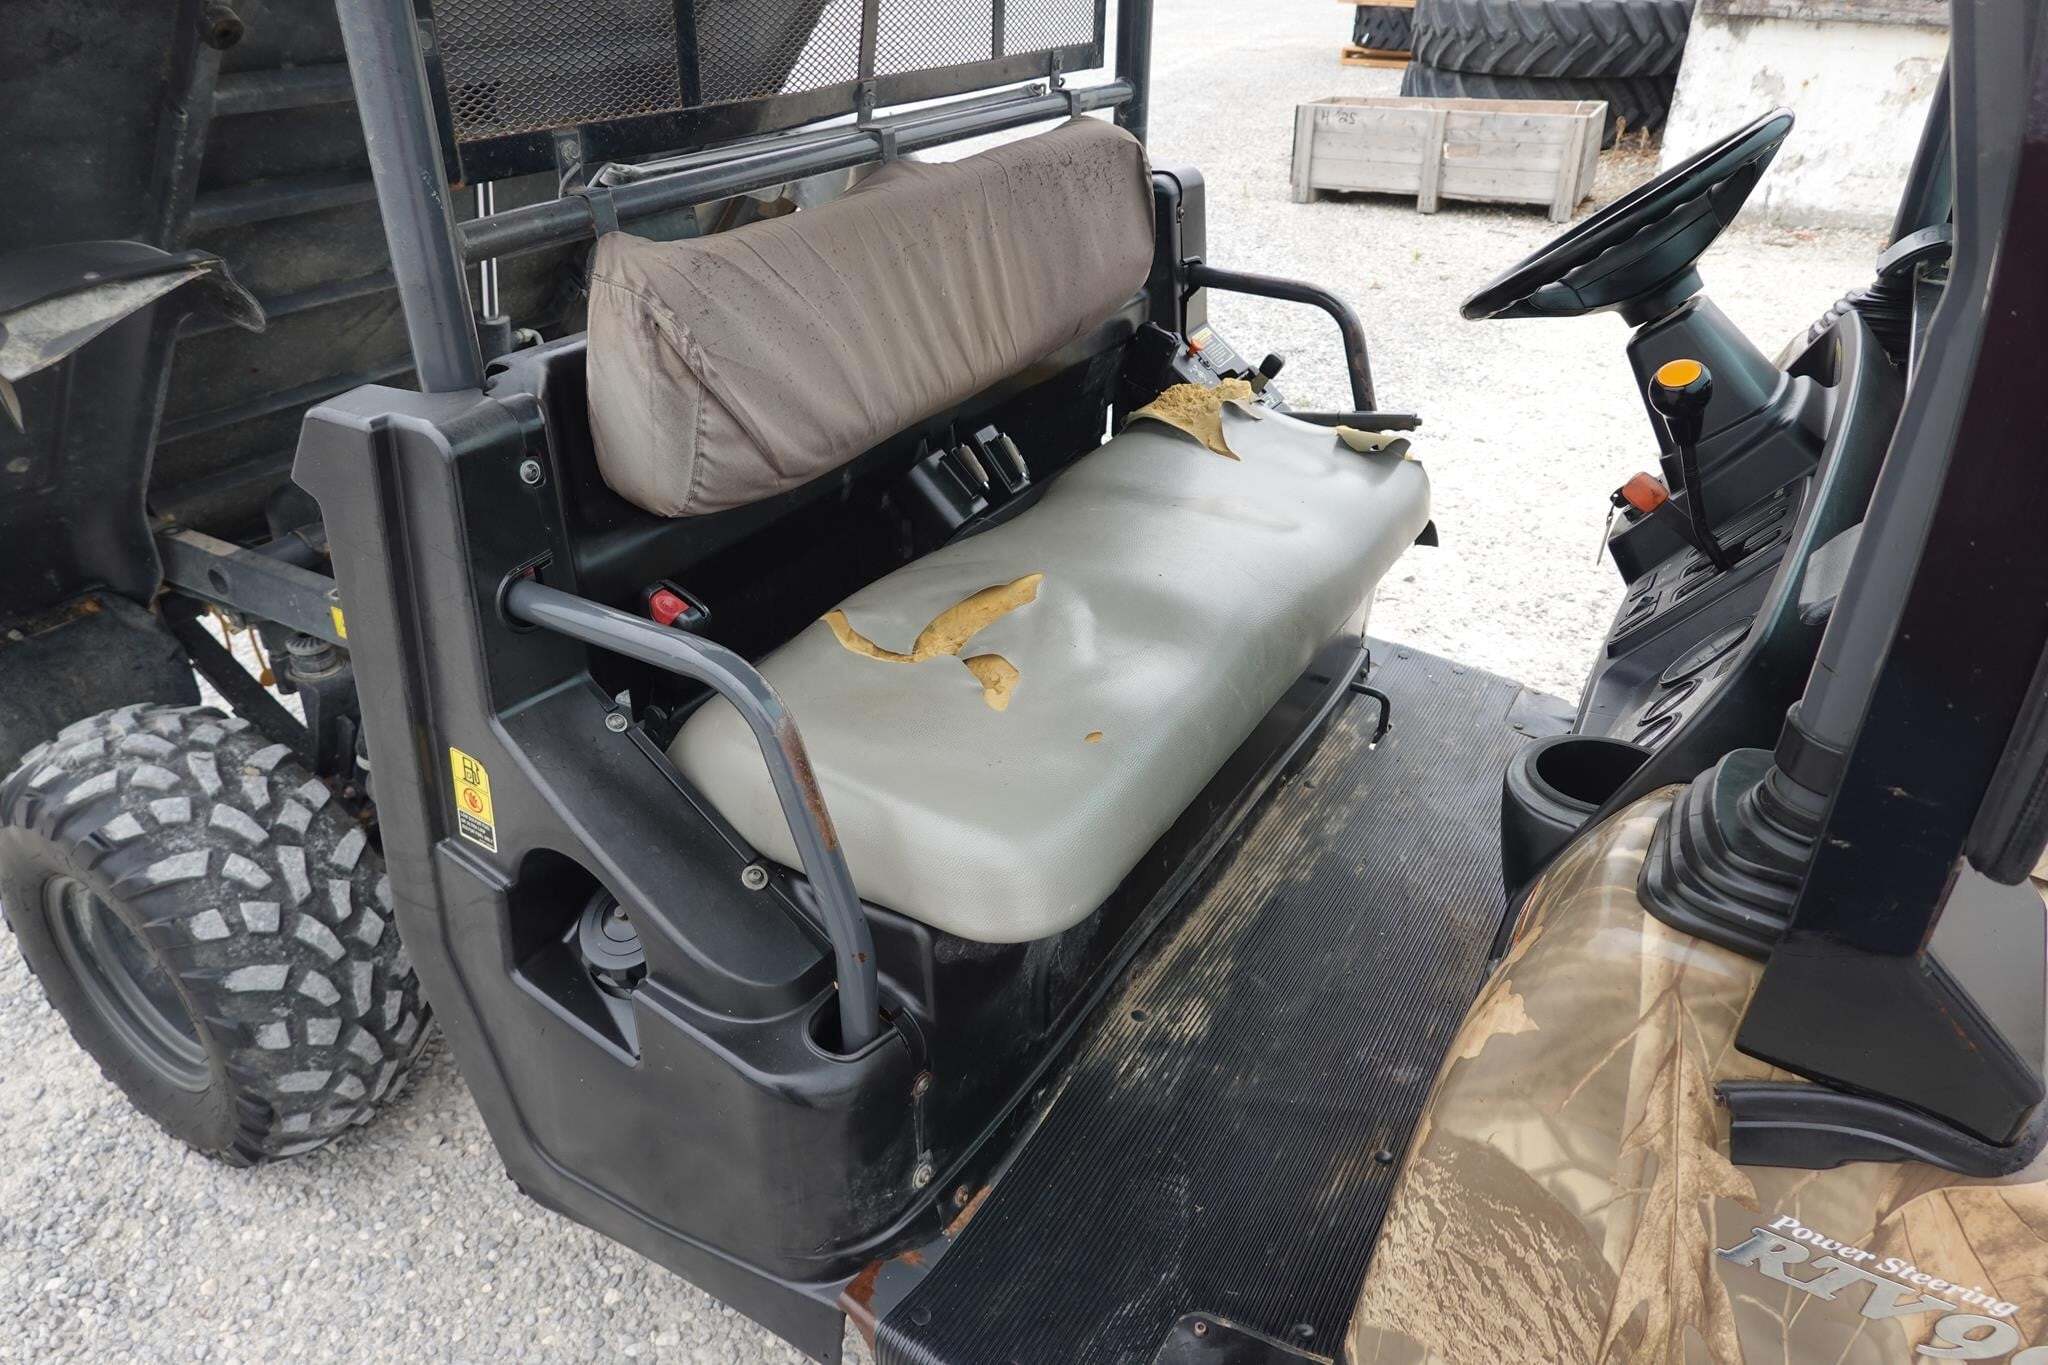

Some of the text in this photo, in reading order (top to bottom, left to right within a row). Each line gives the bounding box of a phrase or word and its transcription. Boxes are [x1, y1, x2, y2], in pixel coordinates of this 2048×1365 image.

[1713, 1227, 2048, 1365] RTV9
[1768, 1215, 2021, 1317] Power Steering
